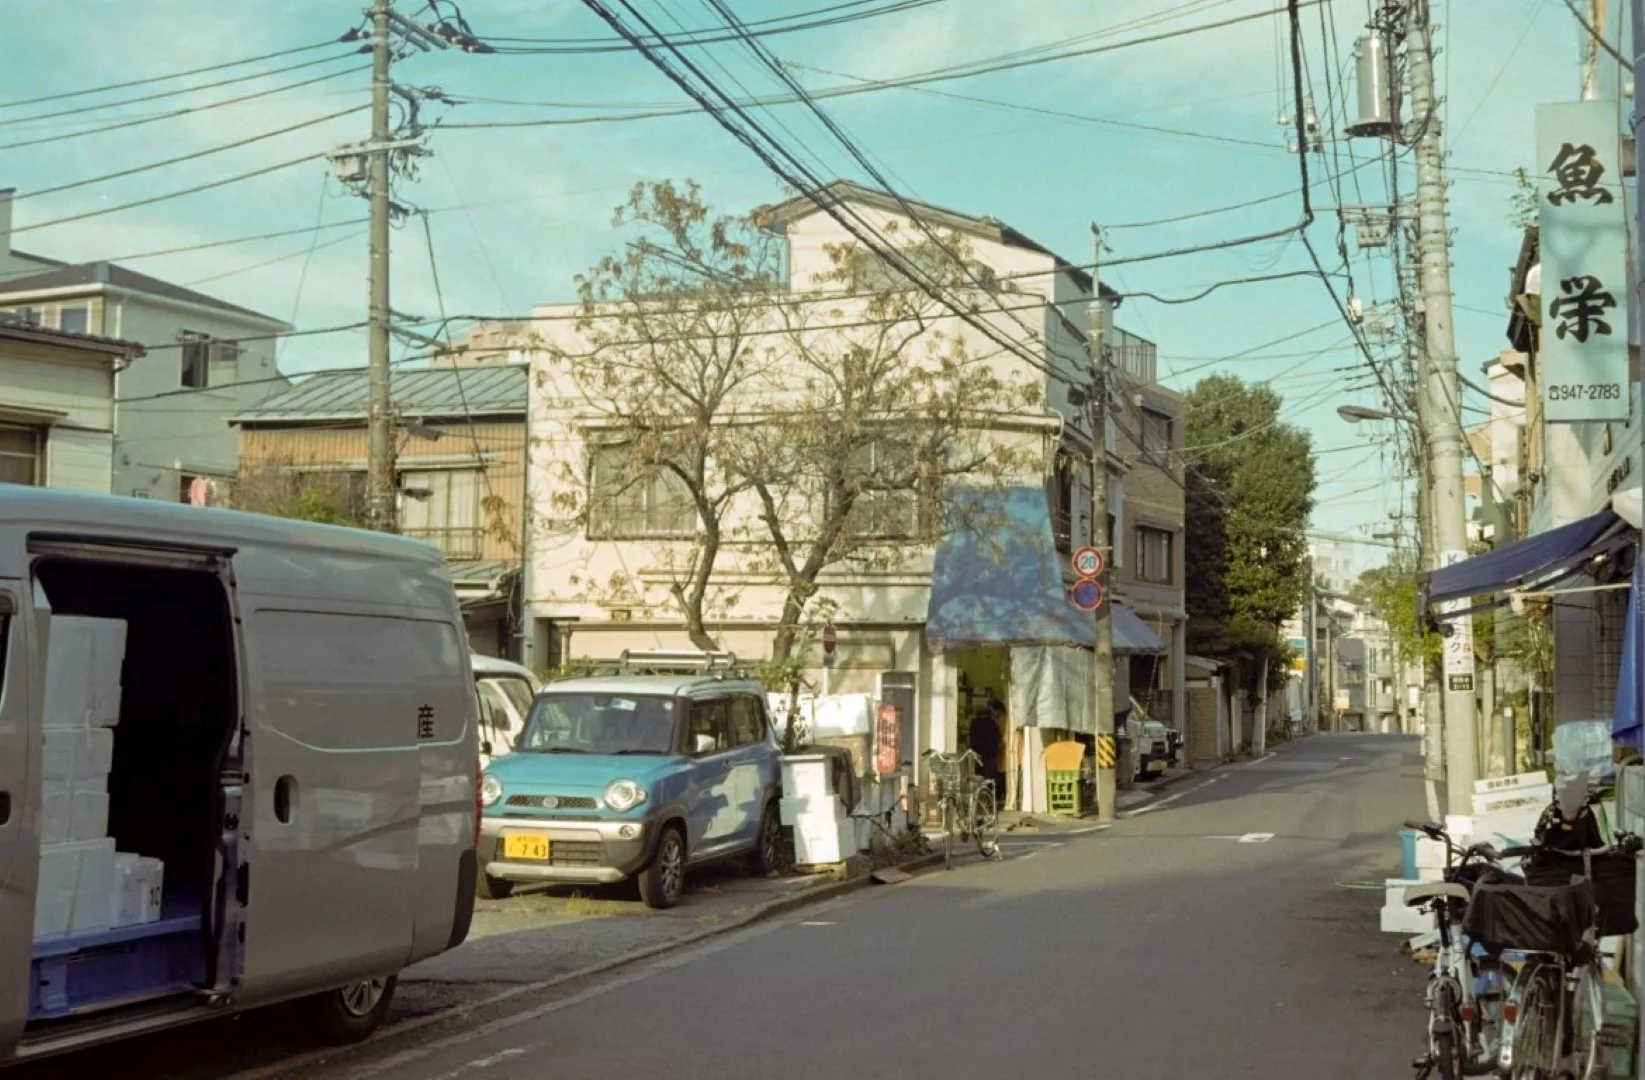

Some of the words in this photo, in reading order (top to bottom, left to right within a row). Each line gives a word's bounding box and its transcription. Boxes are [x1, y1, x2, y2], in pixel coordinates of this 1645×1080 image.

[1547, 142, 1617, 344] 魚栄
[1560, 383, 1621, 401] 947-2783
[1081, 556, 1097, 570] 20
[417, 704, 434, 739] 産
